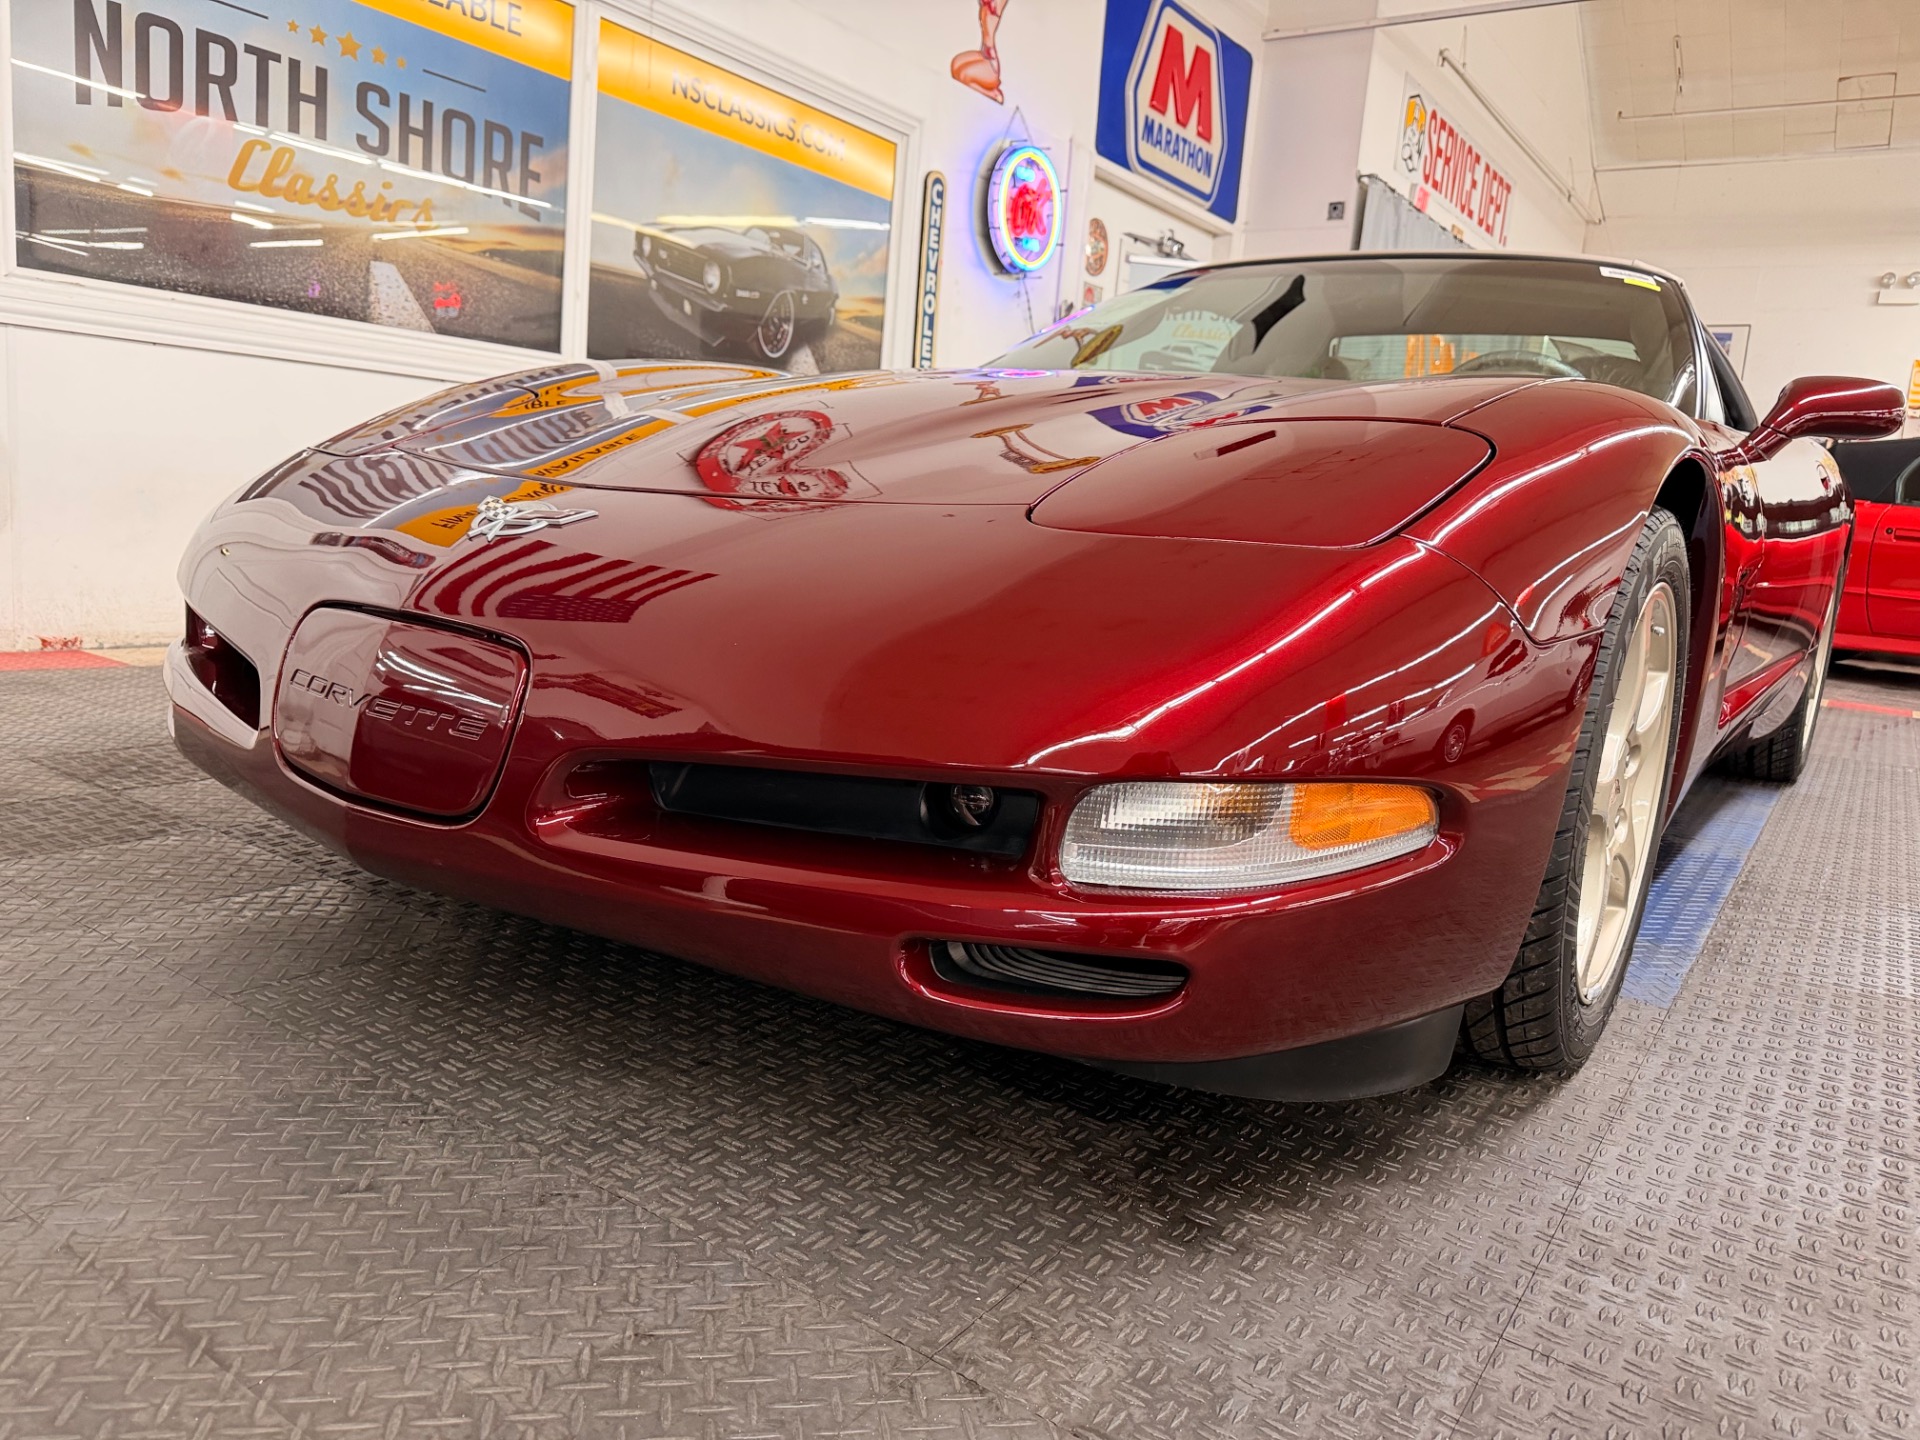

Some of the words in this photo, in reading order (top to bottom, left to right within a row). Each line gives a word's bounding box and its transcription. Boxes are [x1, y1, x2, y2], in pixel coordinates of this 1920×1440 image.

[74, 0, 328, 141] NORTH
[356, 81, 545, 222] SHORE
[672, 68, 846, 162] NSCLASSICS.COM
[1141, 115, 1213, 179] MARATHON
[227, 139, 440, 232] Classics
[1423, 109, 1481, 220] SERVICE
[1477, 161, 1512, 248] DEPT.
[290, 668, 489, 741] CORVETTE
